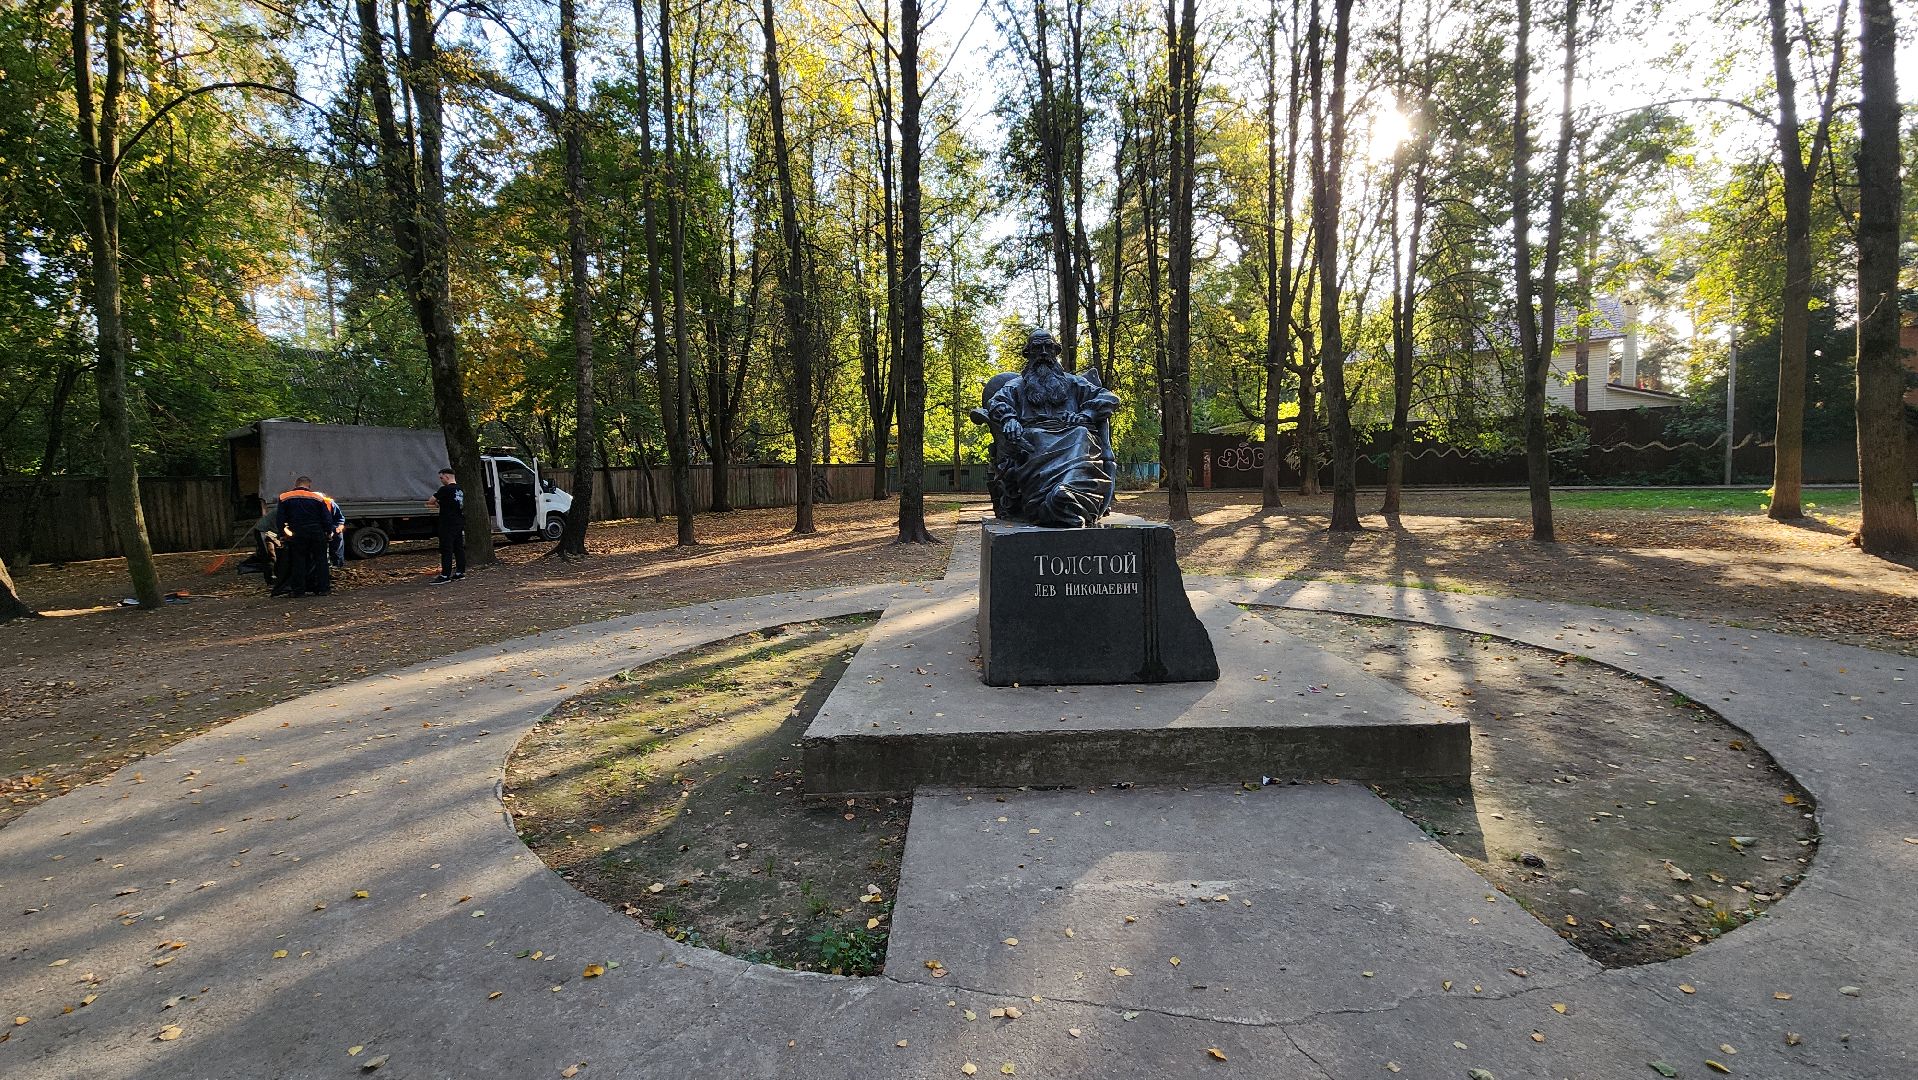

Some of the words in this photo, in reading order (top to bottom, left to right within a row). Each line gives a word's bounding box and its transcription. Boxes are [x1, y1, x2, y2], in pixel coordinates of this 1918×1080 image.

[1033, 551, 1138, 576] ТОЛСТОЙ
[1034, 583, 1057, 597] ЛЕВ
[1065, 582, 1139, 596] НИКОЛАЕВИЧ
